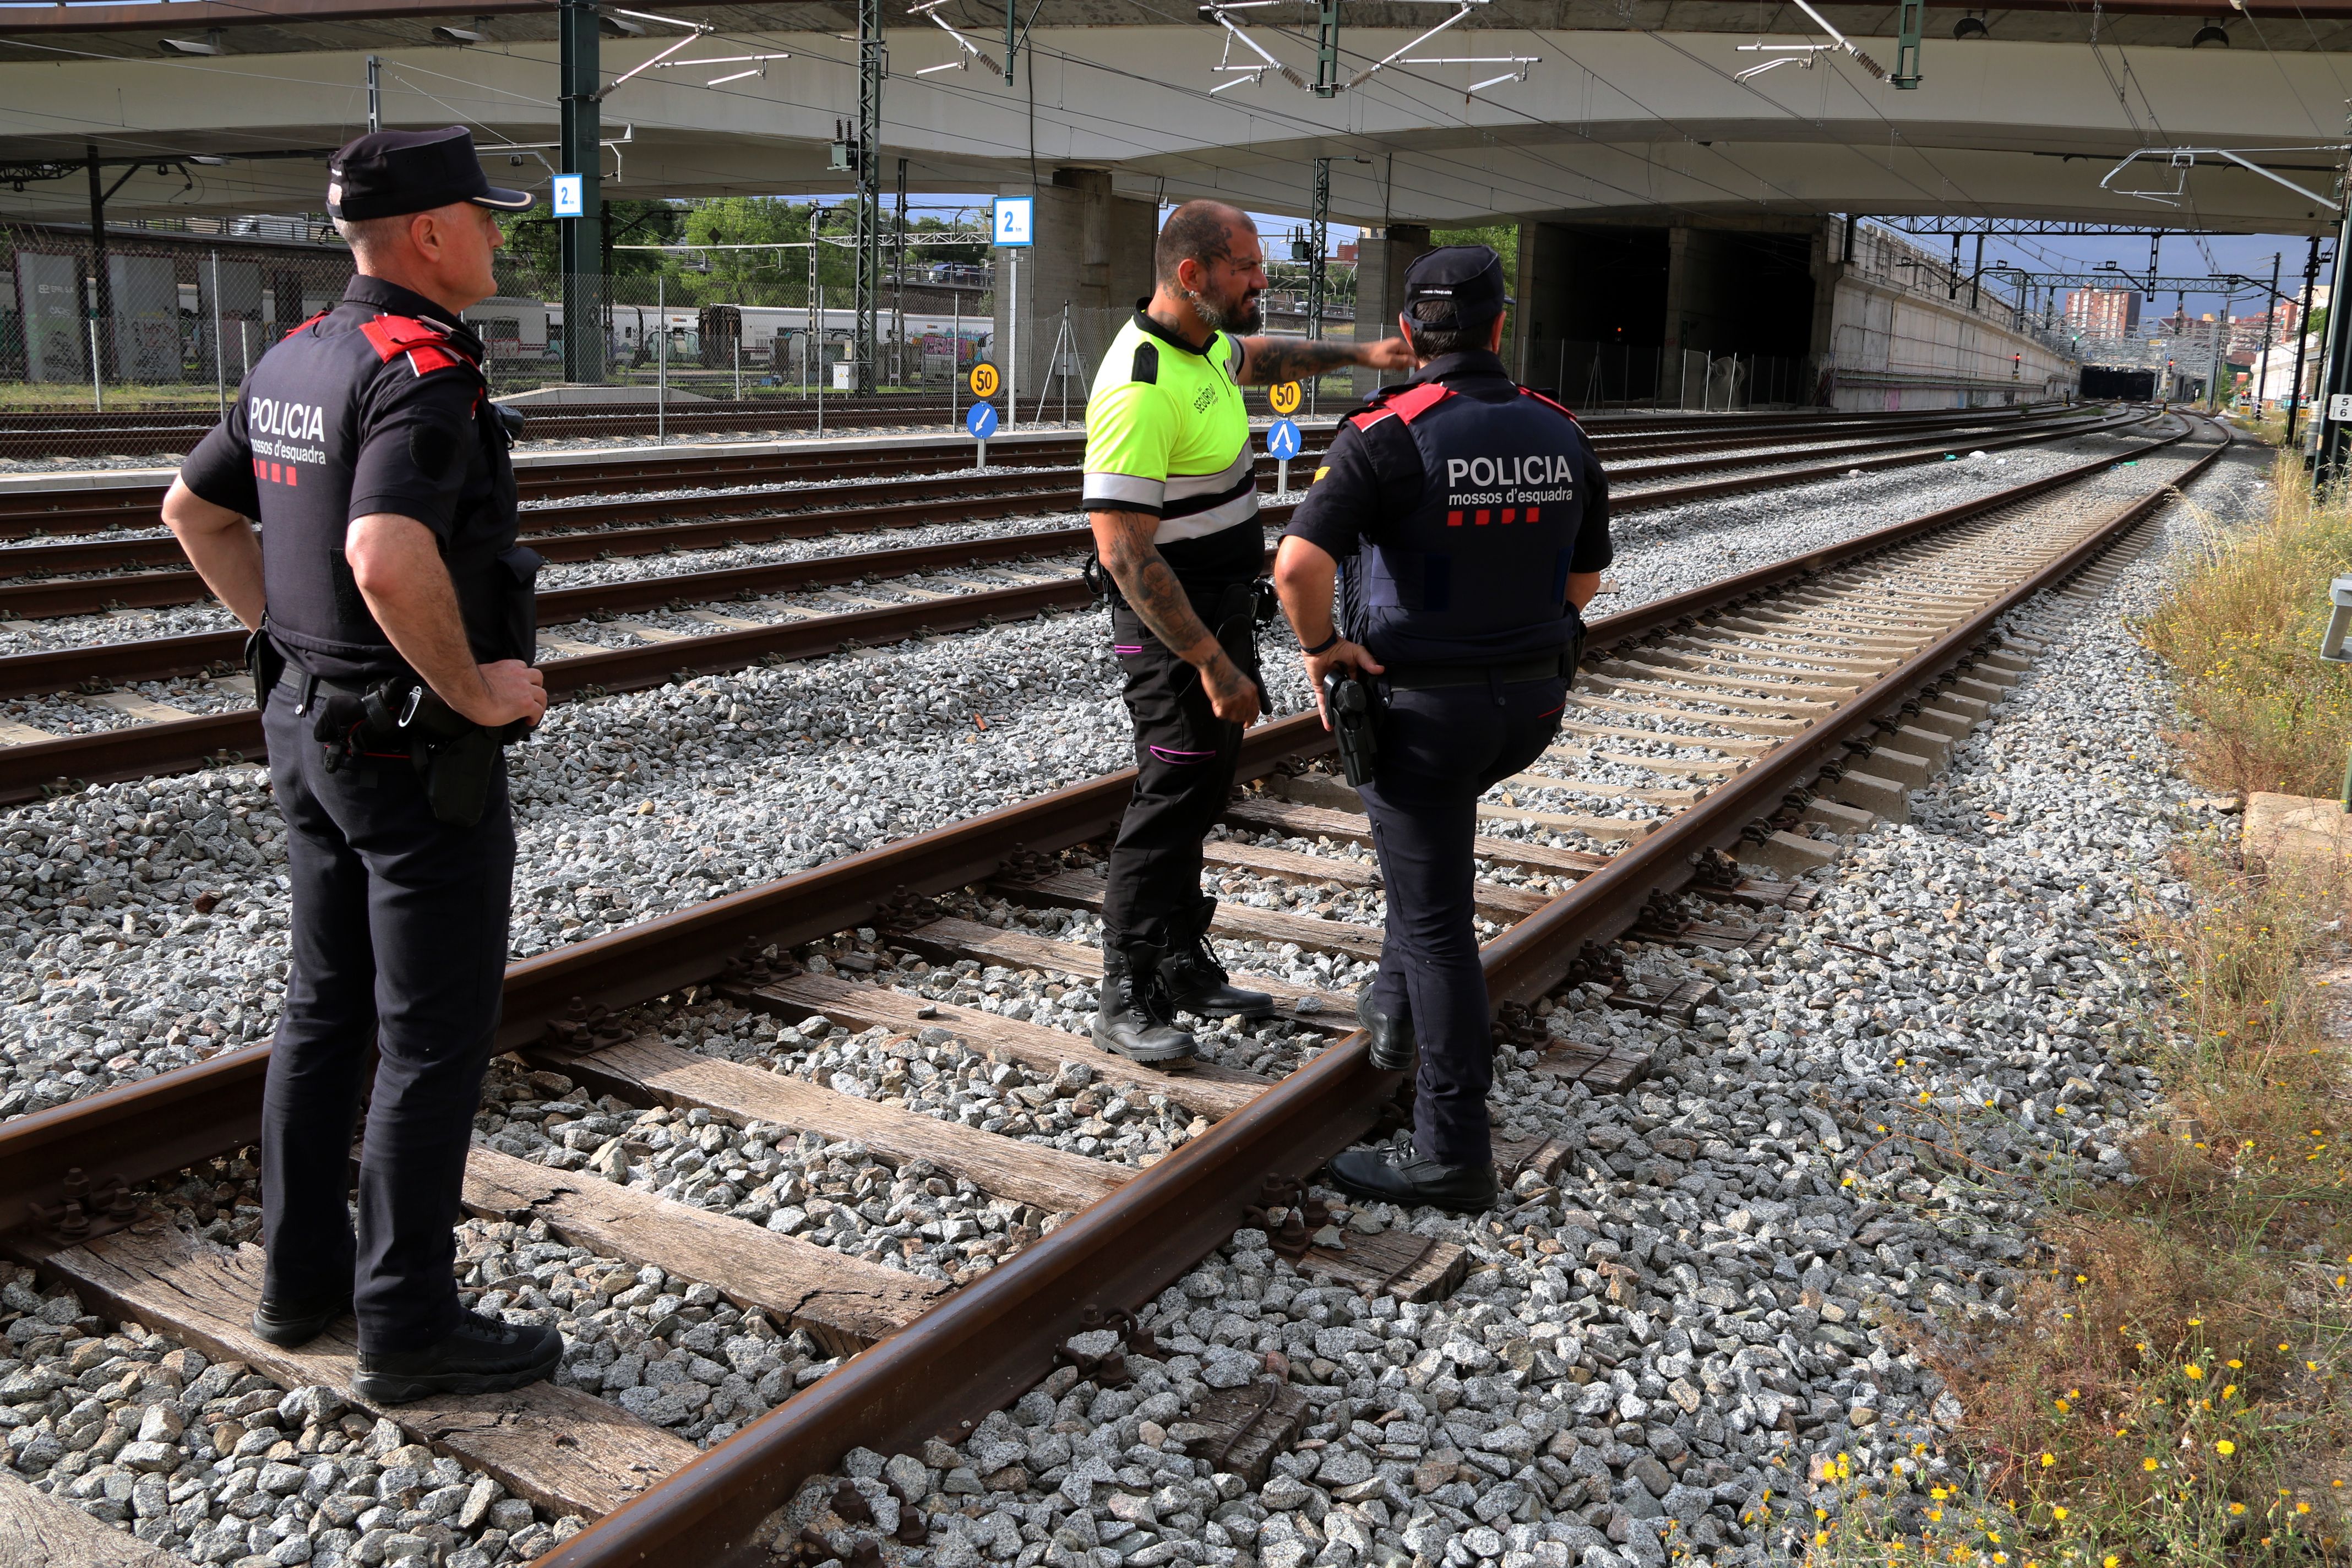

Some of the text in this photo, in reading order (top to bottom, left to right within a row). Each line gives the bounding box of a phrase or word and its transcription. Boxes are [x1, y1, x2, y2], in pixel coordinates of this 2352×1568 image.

[562, 187, 568, 204] 2
[1004, 211, 1013, 232] 2
[976, 371, 992, 391] 50
[1276, 384, 1294, 406] 50
[2341, 398, 2349, 406] 5
[250, 396, 325, 443] POLICIA
[2340, 409, 2348, 417] 6
[274, 439, 326, 465] d'esquadra
[1447, 455, 1573, 487] POLICIA
[1449, 486, 1573, 505] mossos d'esquadra
